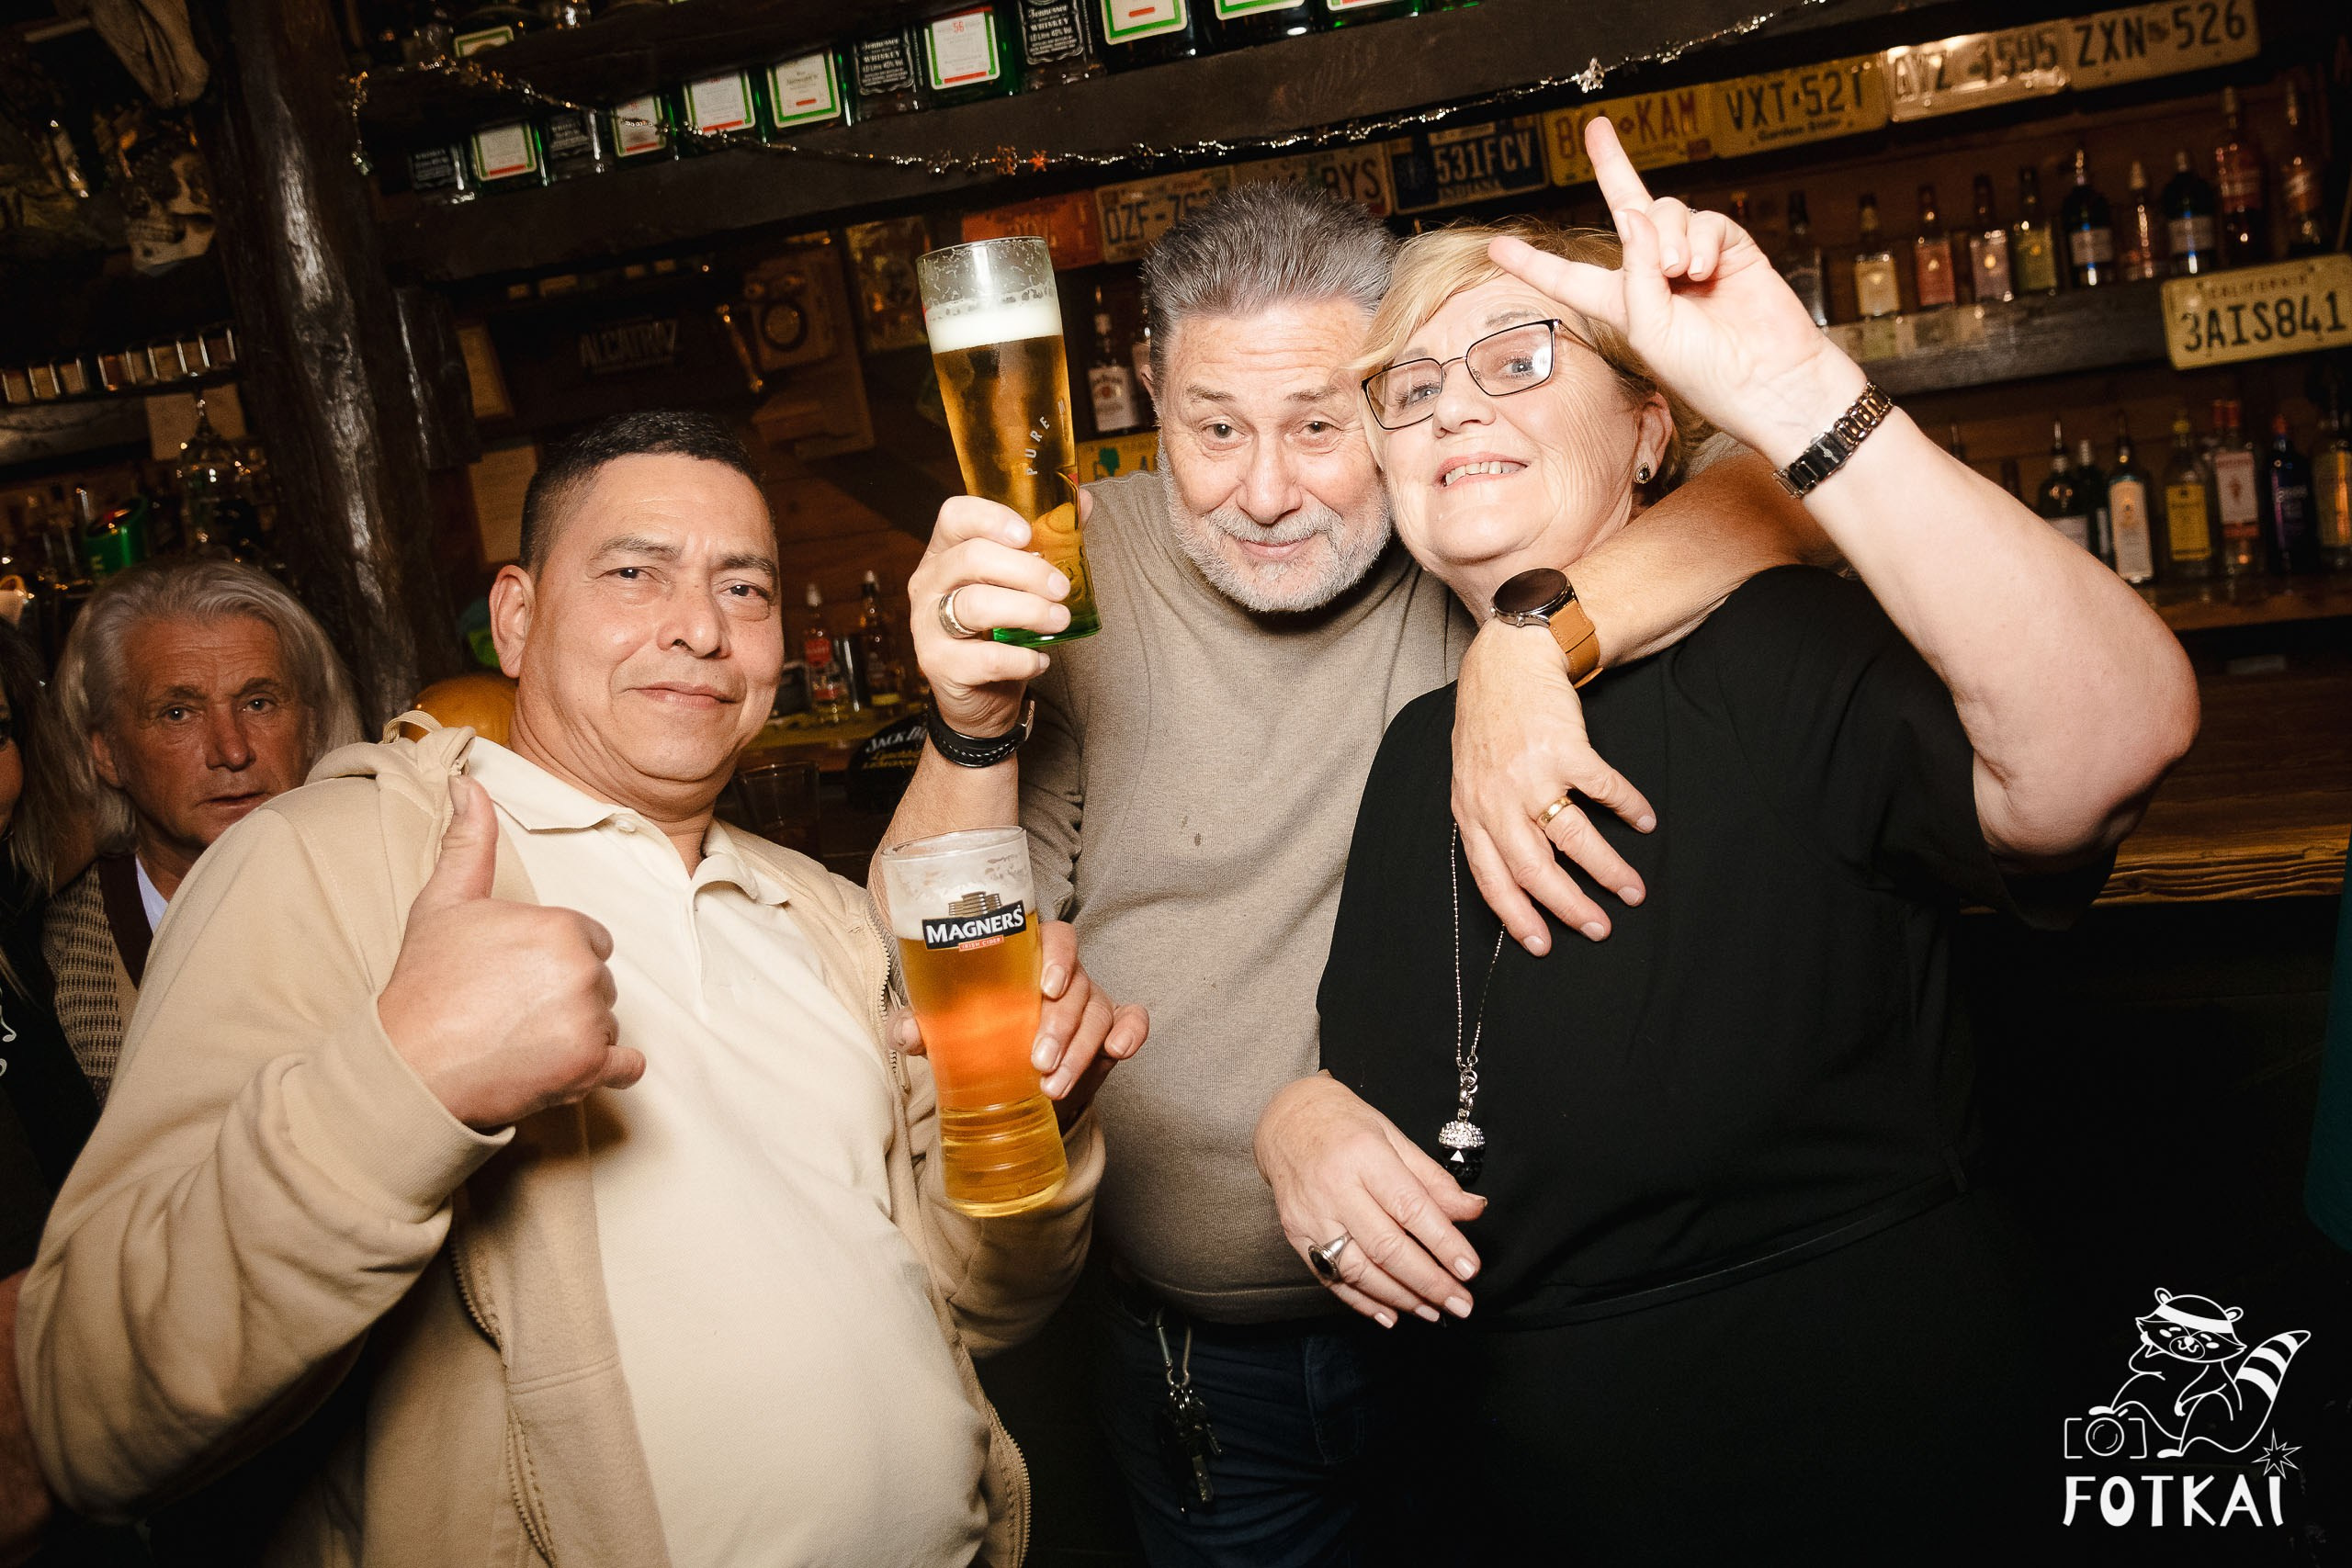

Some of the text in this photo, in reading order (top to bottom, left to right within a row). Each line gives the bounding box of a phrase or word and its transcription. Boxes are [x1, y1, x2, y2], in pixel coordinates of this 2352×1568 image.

[1030, 17, 1069, 31] WHISKEY
[2075, 0, 2245, 67] ZXN 526
[864, 50, 901, 63] WHISKEY
[1635, 91, 1699, 143] KAM
[1432, 130, 1532, 185] 531FCV
[2181, 290, 2346, 352] 3AIS841
[1024, 416, 1050, 476] PURE
[962, 937, 1001, 950] IRISH CIDER
